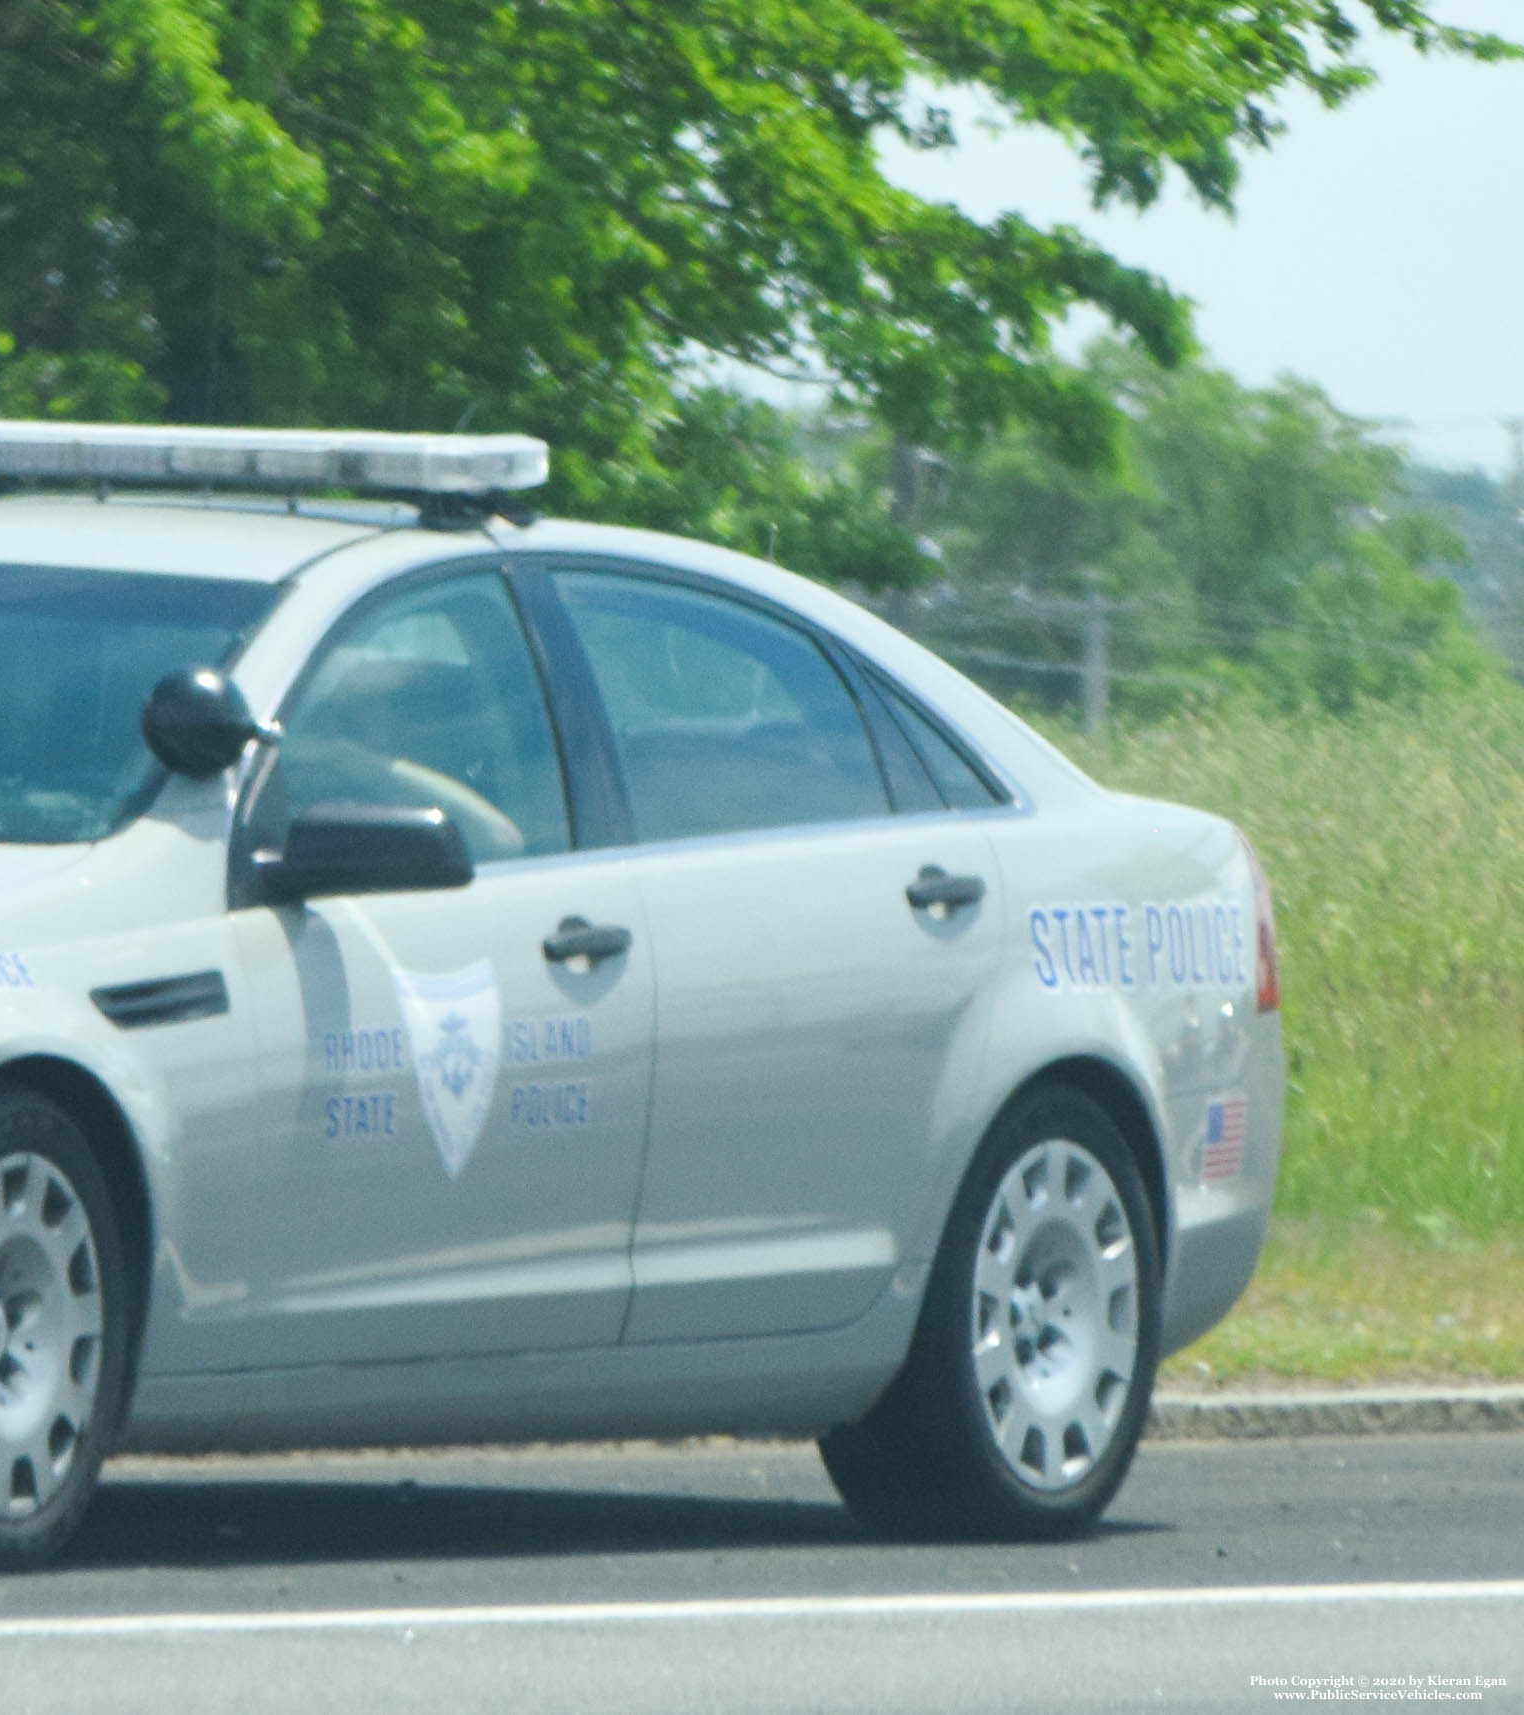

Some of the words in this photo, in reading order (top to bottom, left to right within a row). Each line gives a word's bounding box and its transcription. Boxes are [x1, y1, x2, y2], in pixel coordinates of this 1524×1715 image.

[1029, 907, 1133, 987] STATE
[1145, 906, 1245, 984] POLICE
[323, 1027, 404, 1072] RHODE
[505, 1017, 590, 1062] ISLAND
[326, 1094, 396, 1138] STATE
[511, 1083, 588, 1127] POLICE
